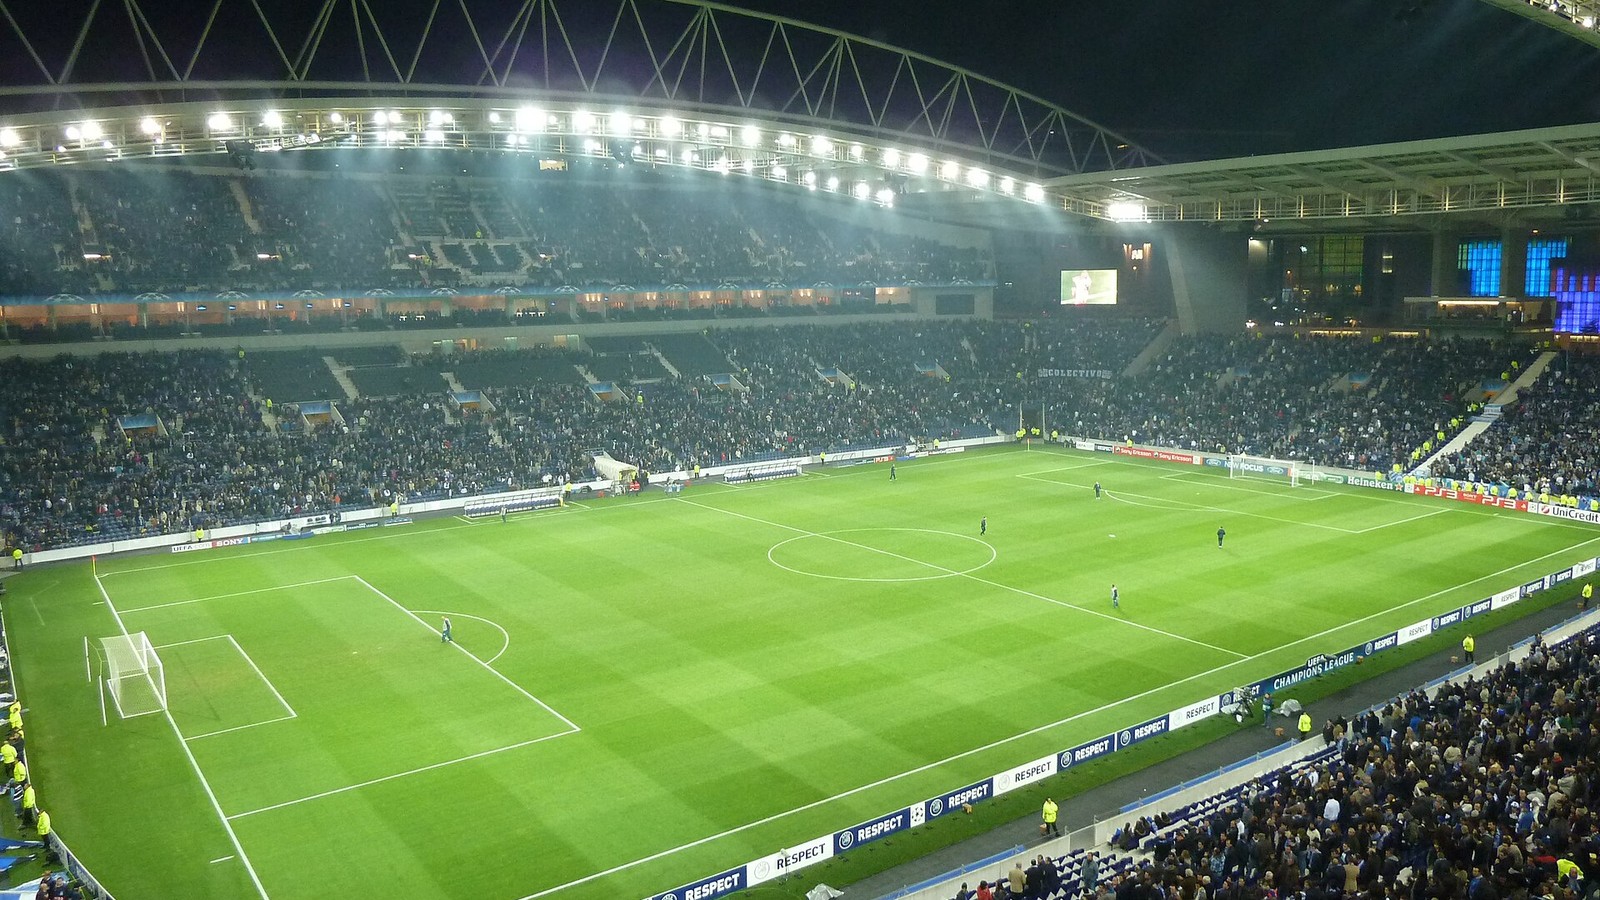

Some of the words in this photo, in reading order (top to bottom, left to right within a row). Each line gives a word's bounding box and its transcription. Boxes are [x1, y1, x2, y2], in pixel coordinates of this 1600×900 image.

[1048, 368, 1102, 378] COLECTIVO
[1120, 448, 1132, 456] Sony
[1133, 449, 1152, 457] Ericsson
[1171, 454, 1192, 462] Ericsson
[1347, 475, 1393, 490] Heineken
[1424, 486, 1458, 499] PS3
[1482, 495, 1517, 509] PS3
[1552, 505, 1599, 523] UniCredit
[217, 538, 243, 547] SONY
[1556, 569, 1572, 582] RESPECT
[1527, 581, 1543, 593] RESPECT
[1501, 590, 1518, 602] RESPECT
[1472, 600, 1491, 613] RESPECT
[1440, 612, 1460, 625] RESPECT
[1408, 623, 1429, 638] RESPECT
[1374, 635, 1396, 650] RESPECT
[1273, 663, 1323, 690] CHAMPIONS
[1324, 652, 1354, 671] LEAGUE
[1186, 702, 1215, 719] RESPECT
[1134, 719, 1167, 739] RESPECT
[1074, 739, 1110, 762] RESPECT
[1015, 761, 1051, 782] RESPECT
[948, 783, 988, 808] RESPECT
[858, 814, 903, 842] RESPECT
[776, 843, 826, 870] RESPECT
[685, 872, 740, 900] RESPECT
